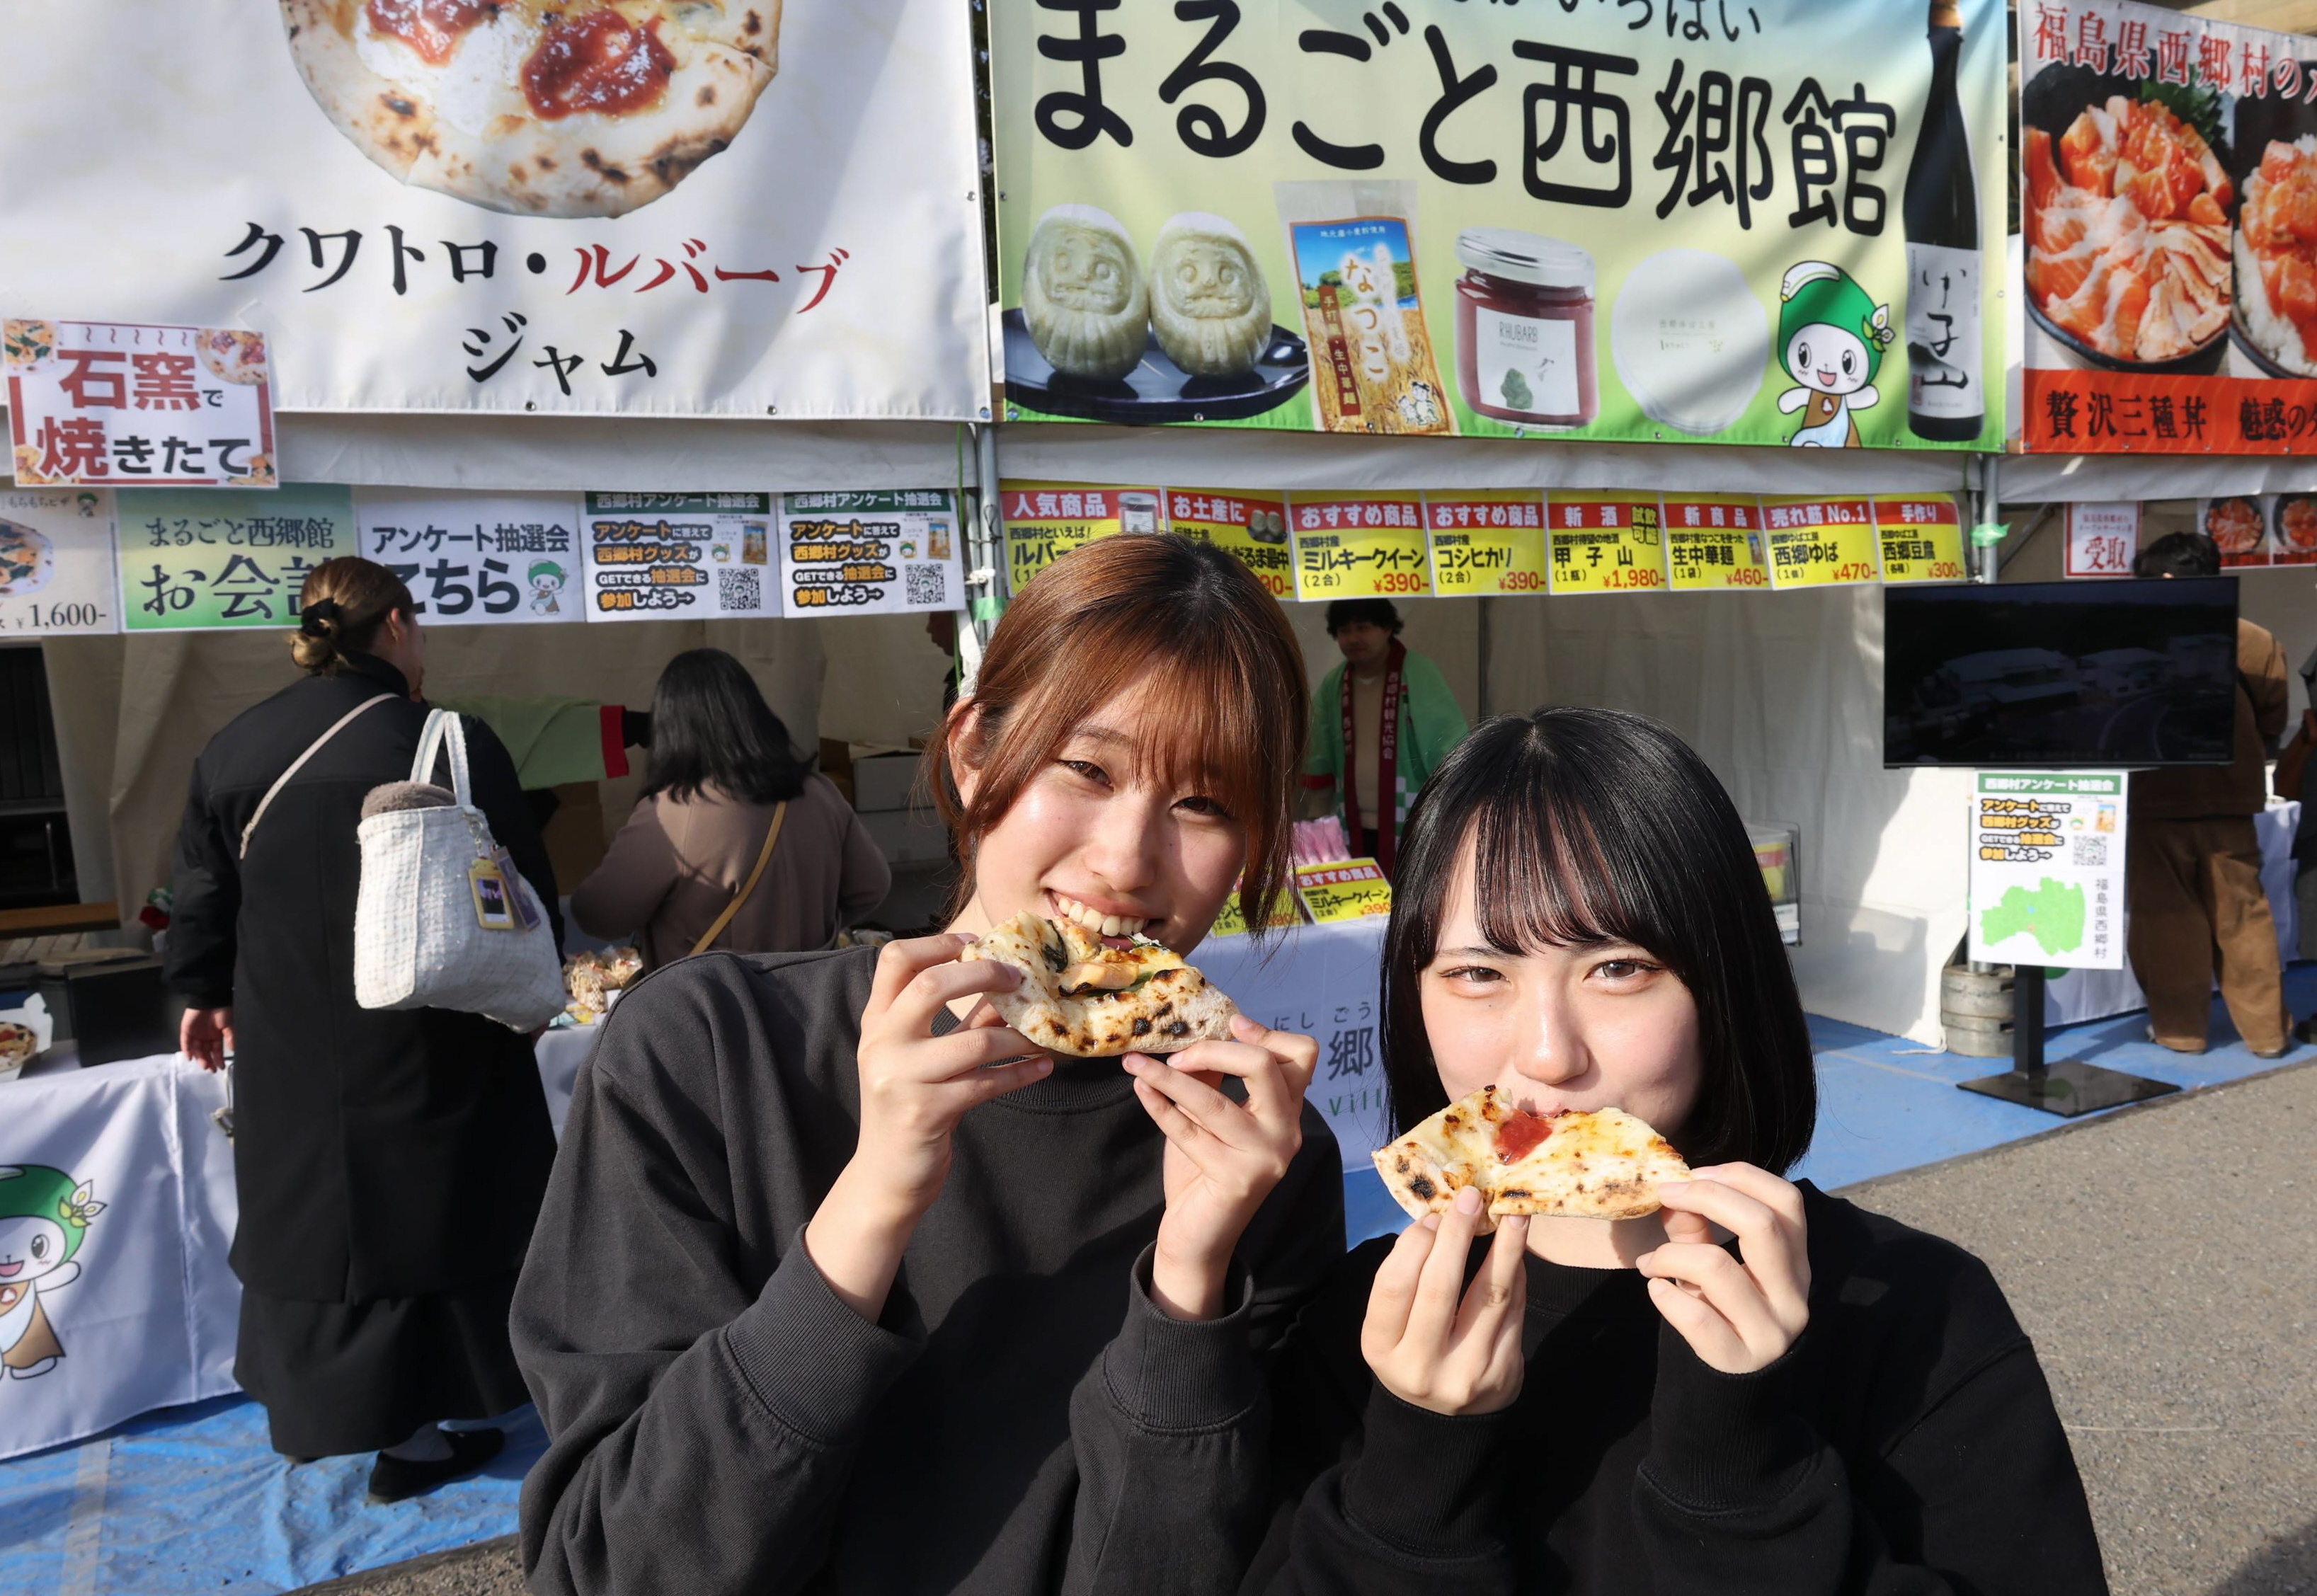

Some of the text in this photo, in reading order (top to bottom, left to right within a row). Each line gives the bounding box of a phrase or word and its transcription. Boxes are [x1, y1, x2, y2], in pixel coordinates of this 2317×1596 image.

[1035, 0, 1896, 236] まるごと西郷館
[218, 222, 850, 314] クワトロ・ルバーブ
[1346, 259, 1383, 374] なつこ
[462, 311, 658, 395] ジャム
[57, 349, 224, 411] 石窯で
[2046, 389, 2207, 440] 贅沢三種丼
[36, 415, 251, 477] 焼きたて
[794, 492, 942, 508] 西郷村アンケート抽選会
[1012, 493, 1106, 517] 人気商品
[1174, 495, 1245, 522] お土産に
[1301, 504, 1418, 528] おすすめ商品
[1436, 505, 1539, 527] おすすめ商品
[1770, 504, 1867, 528] 売れ筋 No.1
[1901, 503, 1937, 523] 手作り
[145, 517, 335, 549] まるごと西郷館
[372, 523, 570, 553] アンケート抽選会
[594, 522, 711, 540] アンケートに答えて
[791, 522, 899, 539] アンケートに答えて
[596, 544, 699, 563] 西郷村グッズが
[794, 543, 889, 561] 西郷村グッズが
[1014, 540, 1084, 566] ルバー
[1303, 547, 1425, 572] ミルキークイーン
[1438, 547, 1512, 568] コシヒカリ
[1555, 546, 1633, 568] 甲子山
[1672, 545, 1734, 566] 生中華麺
[1773, 543, 1839, 566] 西郷ゆば
[2083, 536, 2127, 571] 受取
[598, 568, 706, 585] GETできる抽選会に
[794, 566, 896, 582] GETできる抽選会に
[1303, 572, 1341, 587] (2合)
[1374, 573, 1429, 592] ¥390-
[1439, 570, 1471, 585] (2合)
[1499, 571, 1545, 590] ¥390-
[1299, 866, 1378, 886] おすすめ商品
[1359, 901, 1391, 916] ¥390
[1328, 1088, 1382, 1118] Vill
